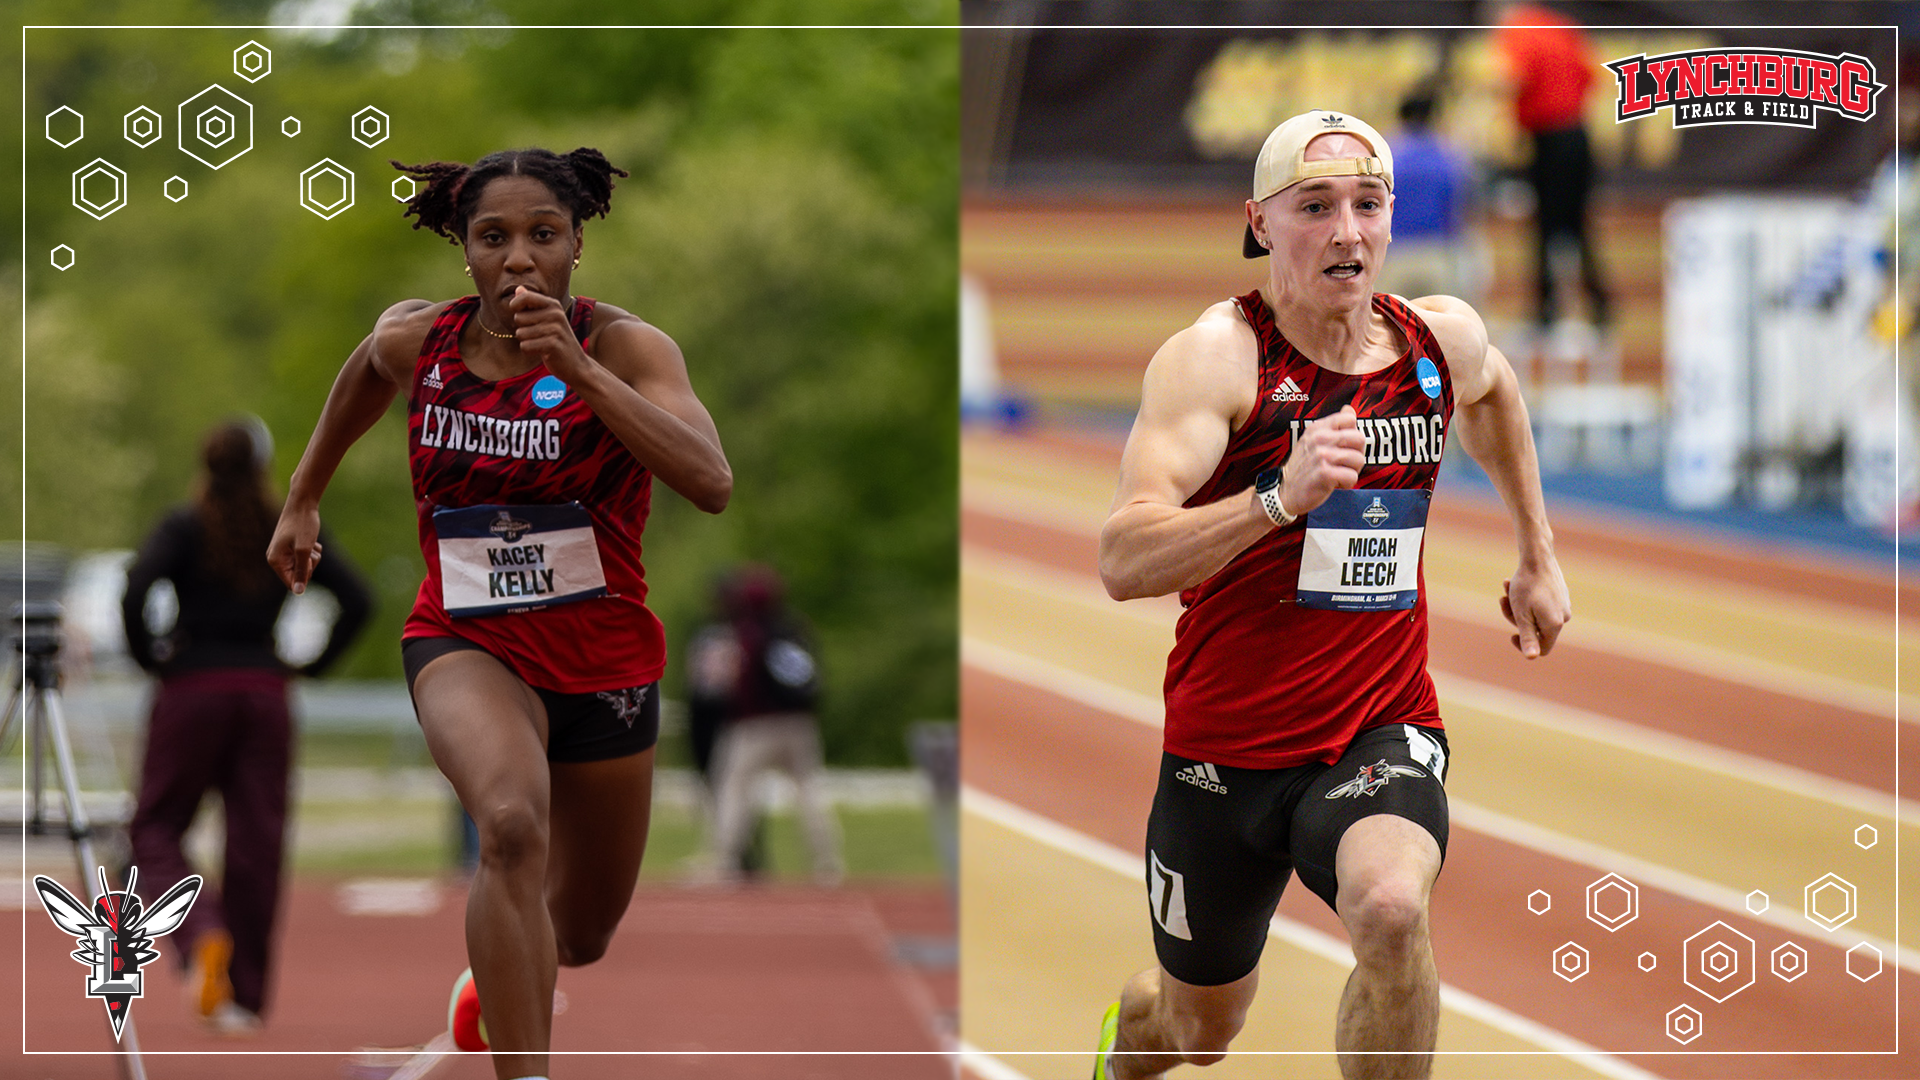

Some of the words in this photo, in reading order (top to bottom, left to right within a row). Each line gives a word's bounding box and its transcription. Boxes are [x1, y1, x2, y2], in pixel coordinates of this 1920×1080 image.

[1421, 376, 1441, 389] NCAA
[536, 390, 564, 400] NCAA
[1271, 391, 1309, 402] adidas
[421, 403, 560, 460] LYNCHBURG
[487, 544, 545, 566] KACEY
[1348, 537, 1397, 557] MICAH
[489, 568, 555, 598] KELLY
[1340, 562, 1397, 586] LEECH
[1175, 771, 1228, 795] adidas
